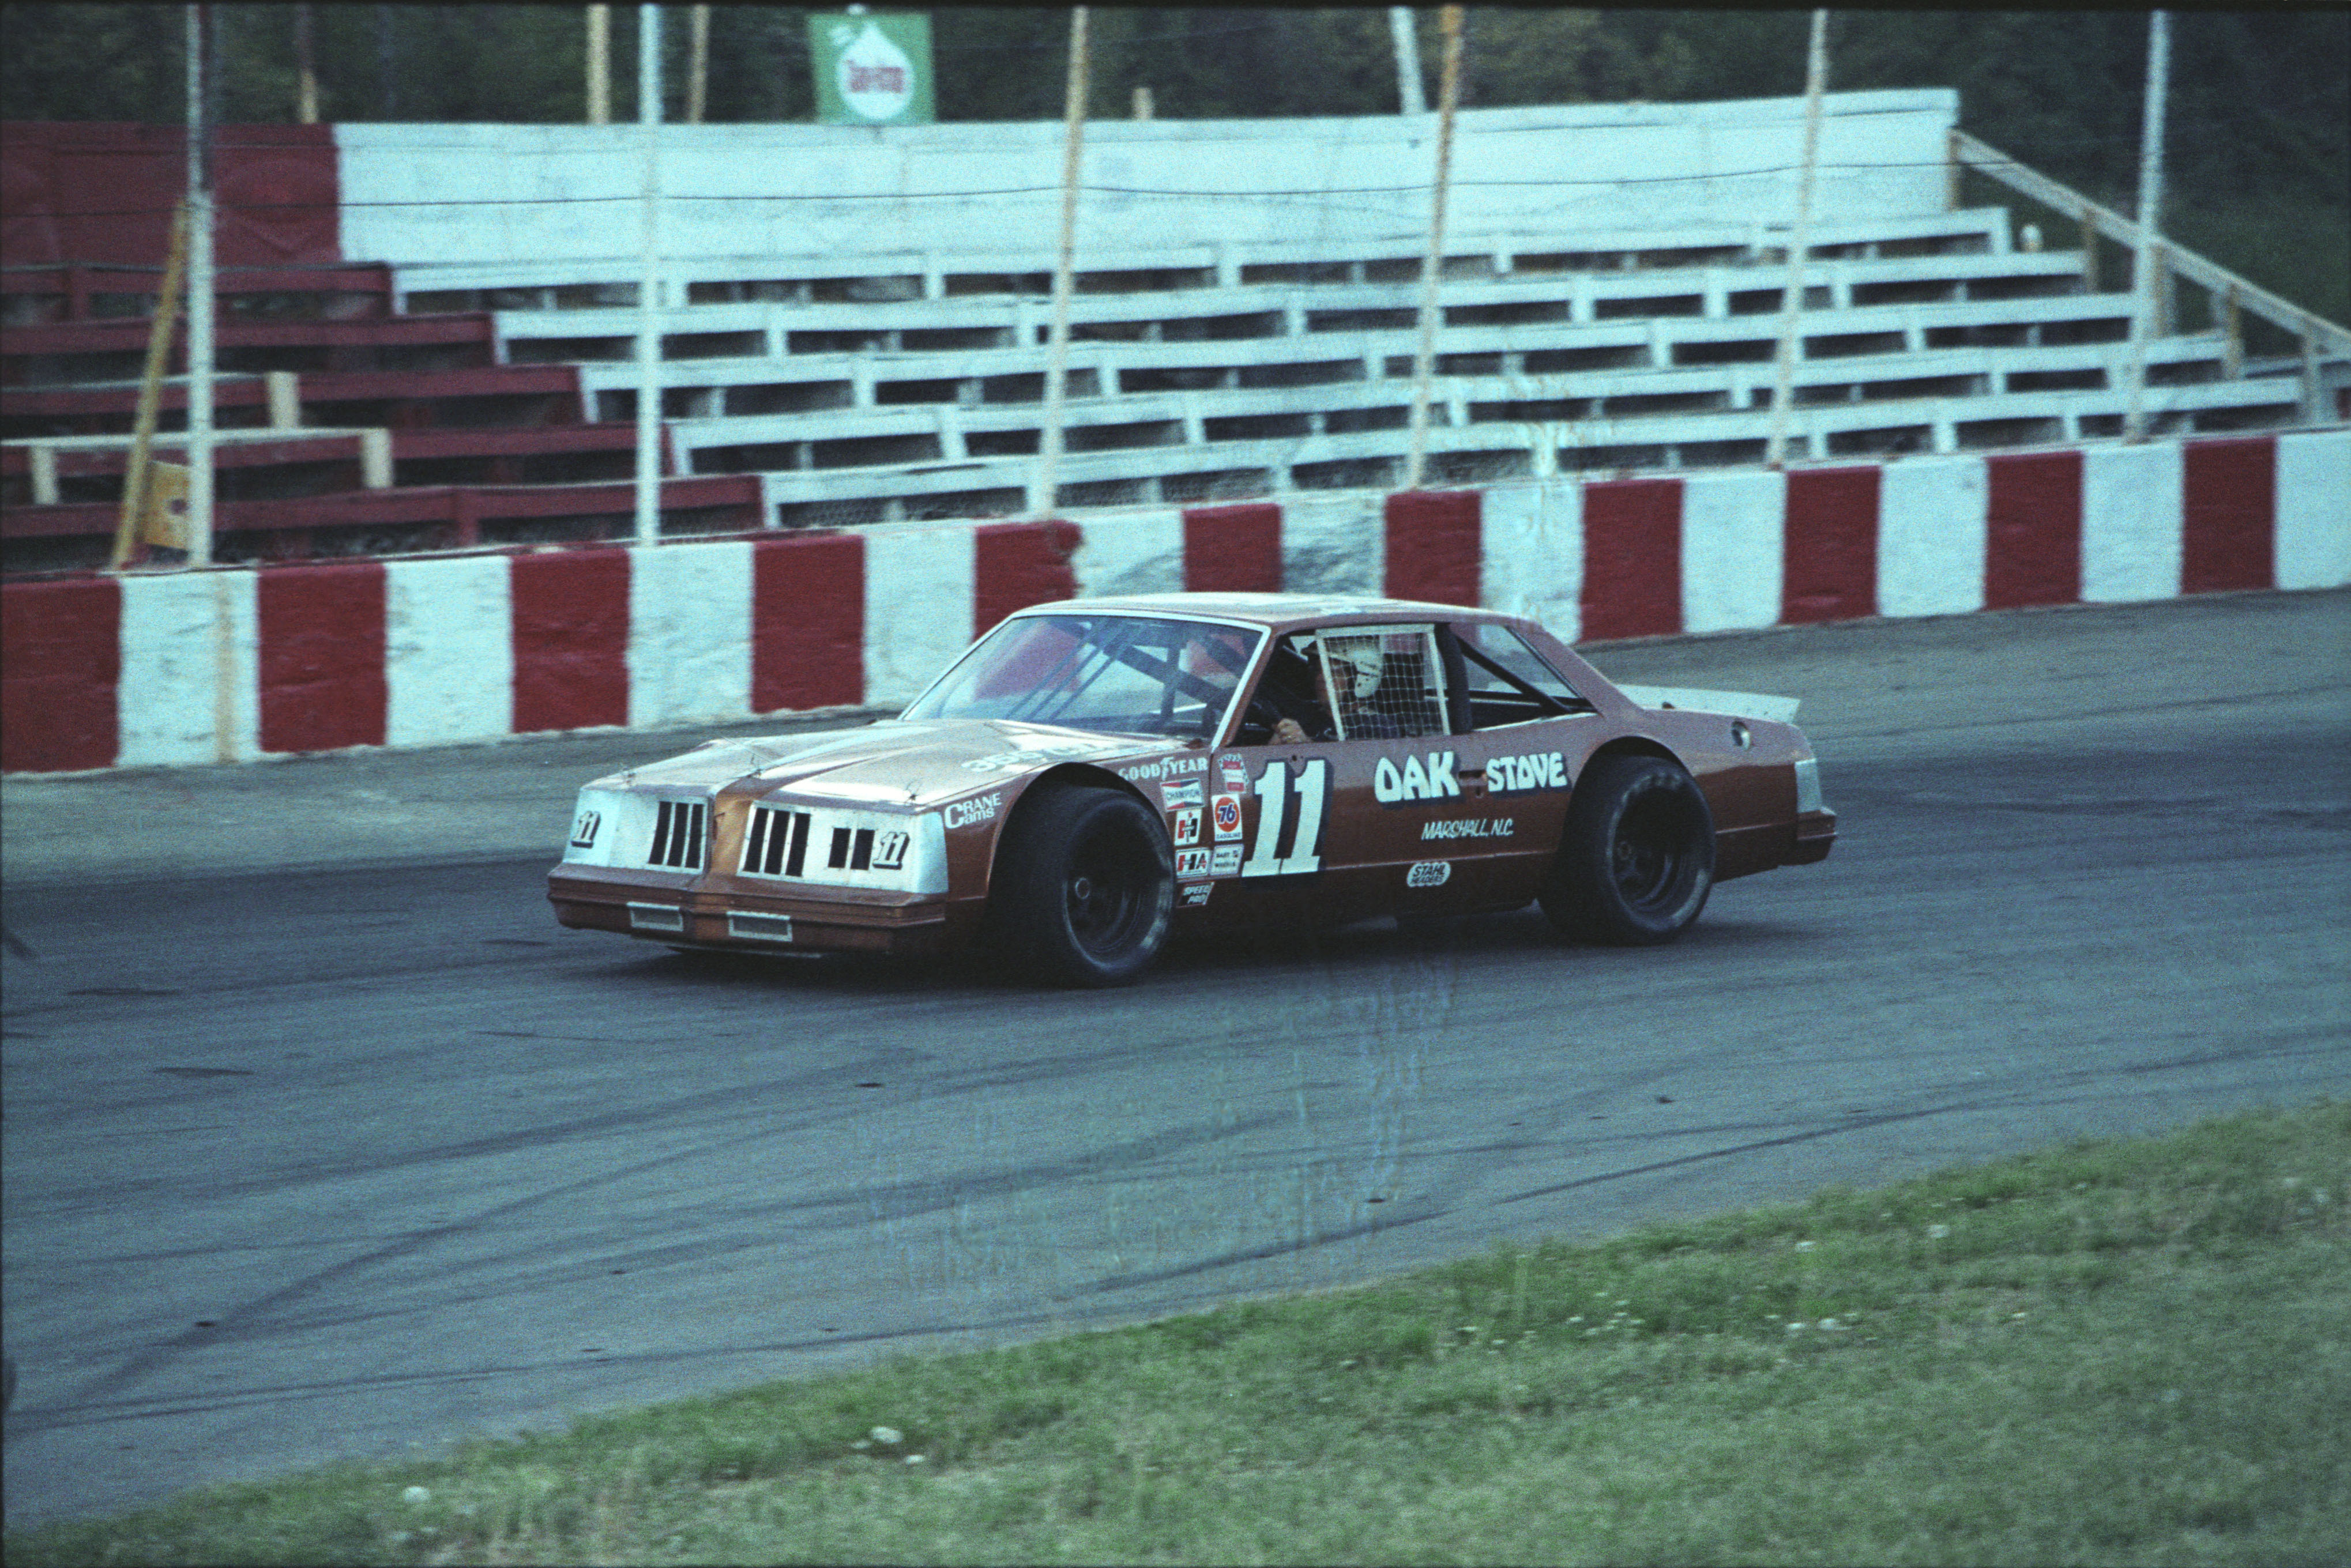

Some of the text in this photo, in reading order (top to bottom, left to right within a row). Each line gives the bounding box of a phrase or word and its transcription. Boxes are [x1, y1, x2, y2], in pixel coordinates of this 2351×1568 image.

[1118, 757, 1208, 781] GOODYEAR
[1375, 751, 1460, 802] OAK
[1486, 752, 1568, 792] STOVE
[945, 793, 1002, 828] CRANE
[1218, 802, 1237, 824] 76
[1242, 759, 1325, 877] 11
[571, 811, 601, 849] 11
[872, 831, 910, 870] 11
